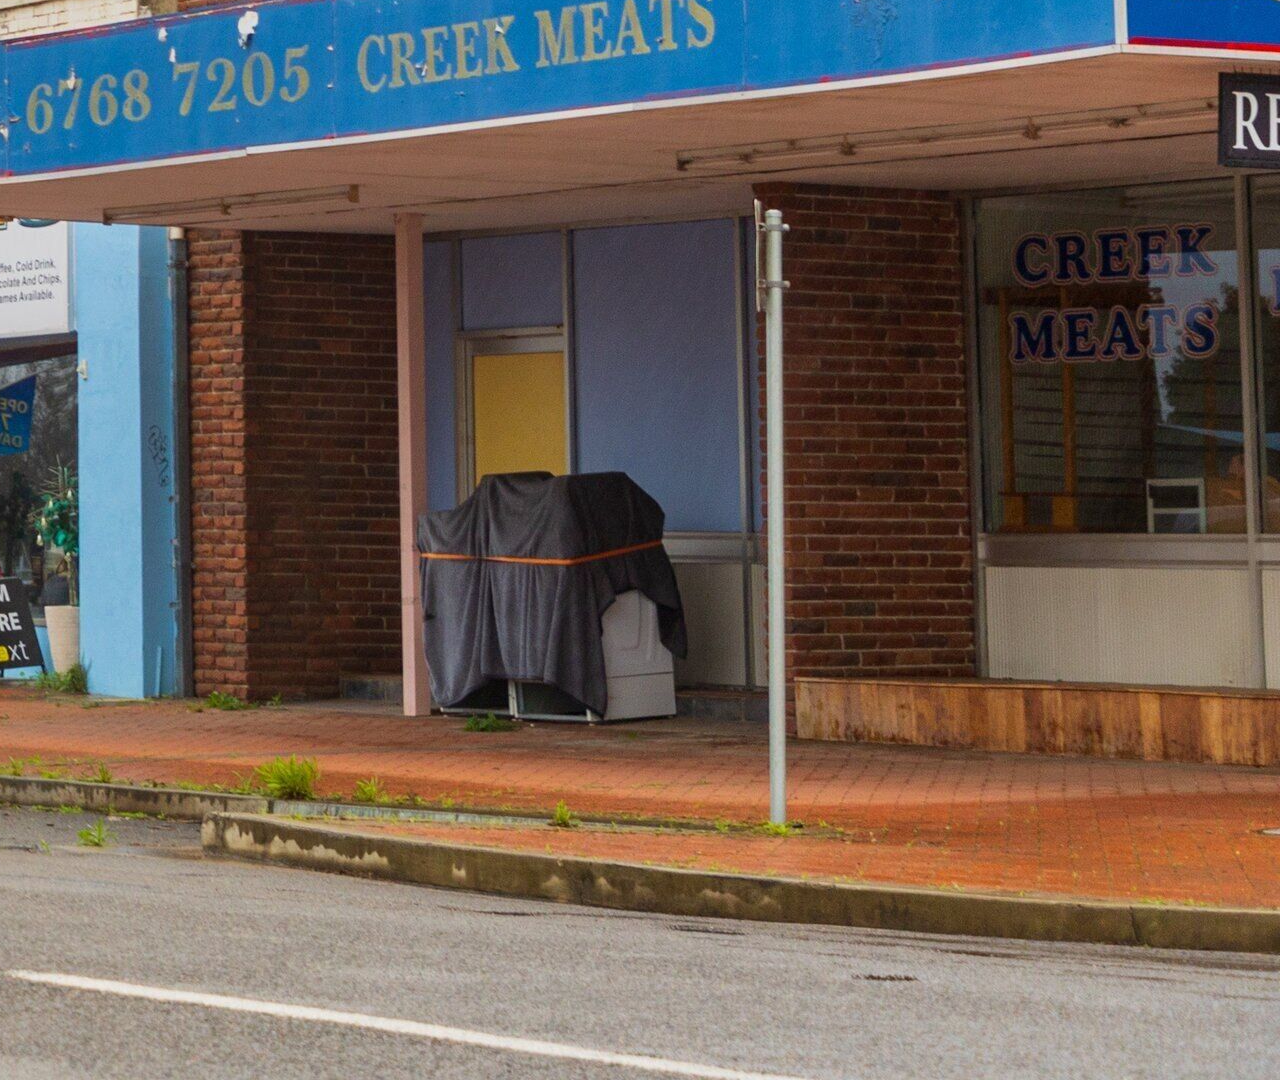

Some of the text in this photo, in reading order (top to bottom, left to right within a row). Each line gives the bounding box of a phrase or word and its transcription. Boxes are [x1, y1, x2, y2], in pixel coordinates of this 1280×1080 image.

[357, 15, 521, 93] CREEK
[26, 68, 151, 134] 6768
[173, 44, 310, 117] 7205
[16, 261, 33, 272] Cold
[22, 275, 37, 286] And
[1012, 222, 1219, 289] CREEK
[1008, 302, 1219, 364] MEATS
